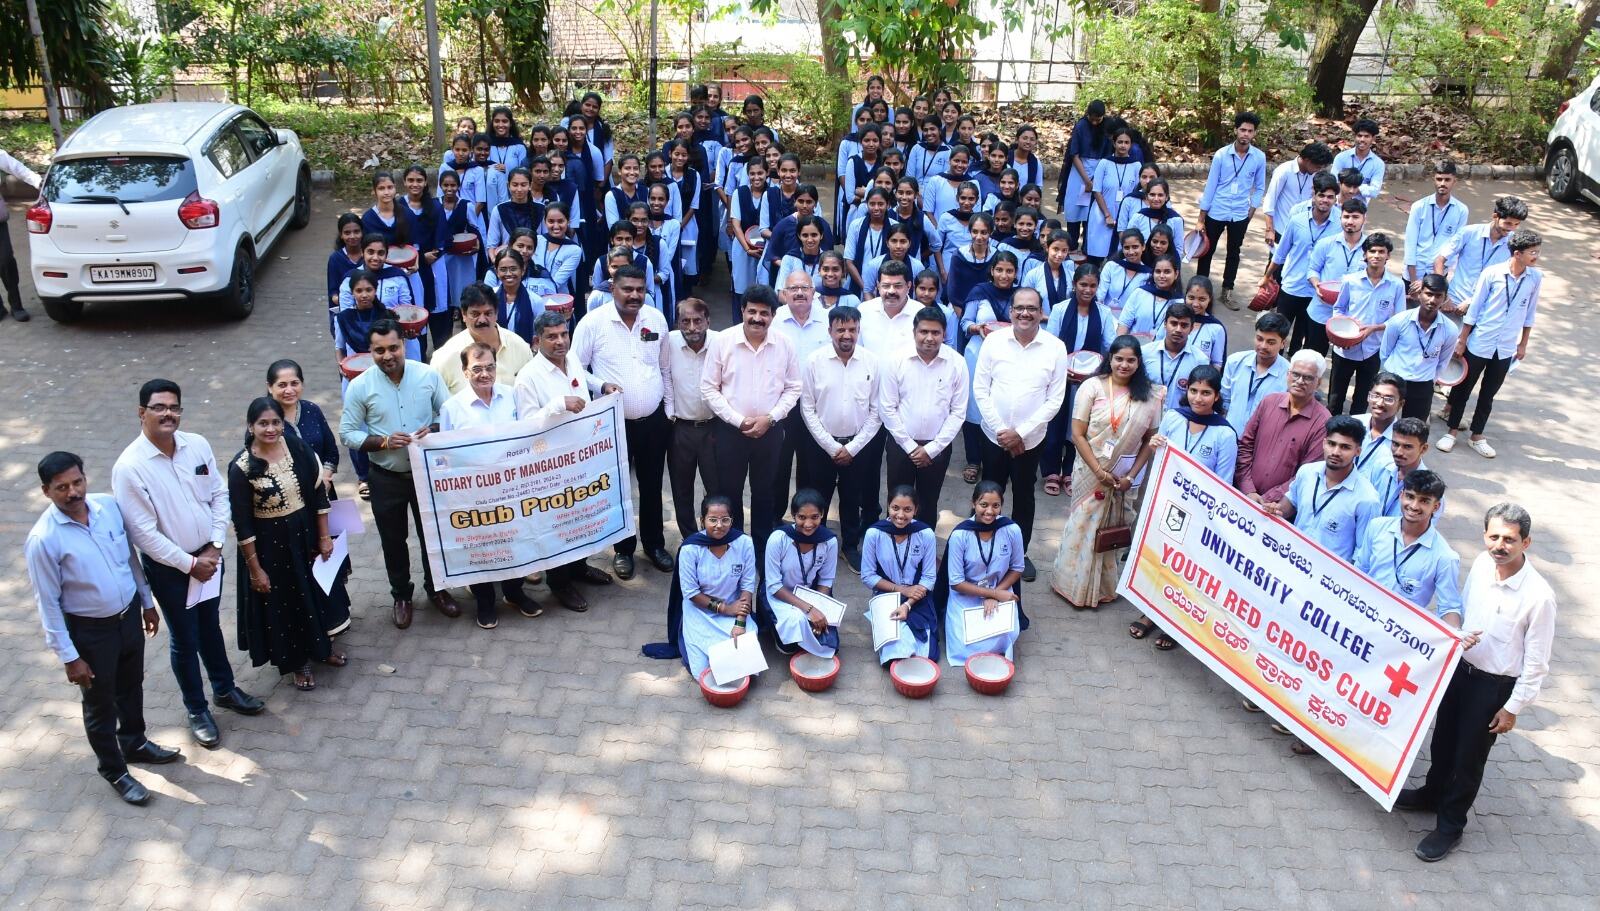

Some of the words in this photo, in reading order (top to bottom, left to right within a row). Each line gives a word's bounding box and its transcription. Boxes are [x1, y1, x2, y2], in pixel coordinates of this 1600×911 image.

[434, 476, 472, 492] ROTARY
[475, 472, 502, 488] CLUB
[504, 468, 517, 482] OF
[519, 452, 576, 478] MANGALORE
[578, 437, 614, 462] CENTRAL
[506, 446, 530, 458] Rotary
[450, 505, 514, 529] Club
[520, 472, 610, 517] Project
[1172, 471, 1257, 537] ವಿಶ್ವವಿದ್ಯಾನಿಲಯ
[1200, 526, 1293, 605] UNIVERSITY
[1299, 600, 1375, 663] COLLEGE
[1160, 542, 1222, 601] YOUTH
[1222, 588, 1262, 630] RED
[1265, 620, 1334, 682] CROSS
[1336, 672, 1392, 726] CLUB
[1163, 585, 1208, 623] ಯುವ
[1213, 620, 1250, 651] ರೆಡ್
[1255, 652, 1303, 692] ಕ್ರಾಸ್
[1307, 693, 1348, 727] ಕ್ಲಬ್
